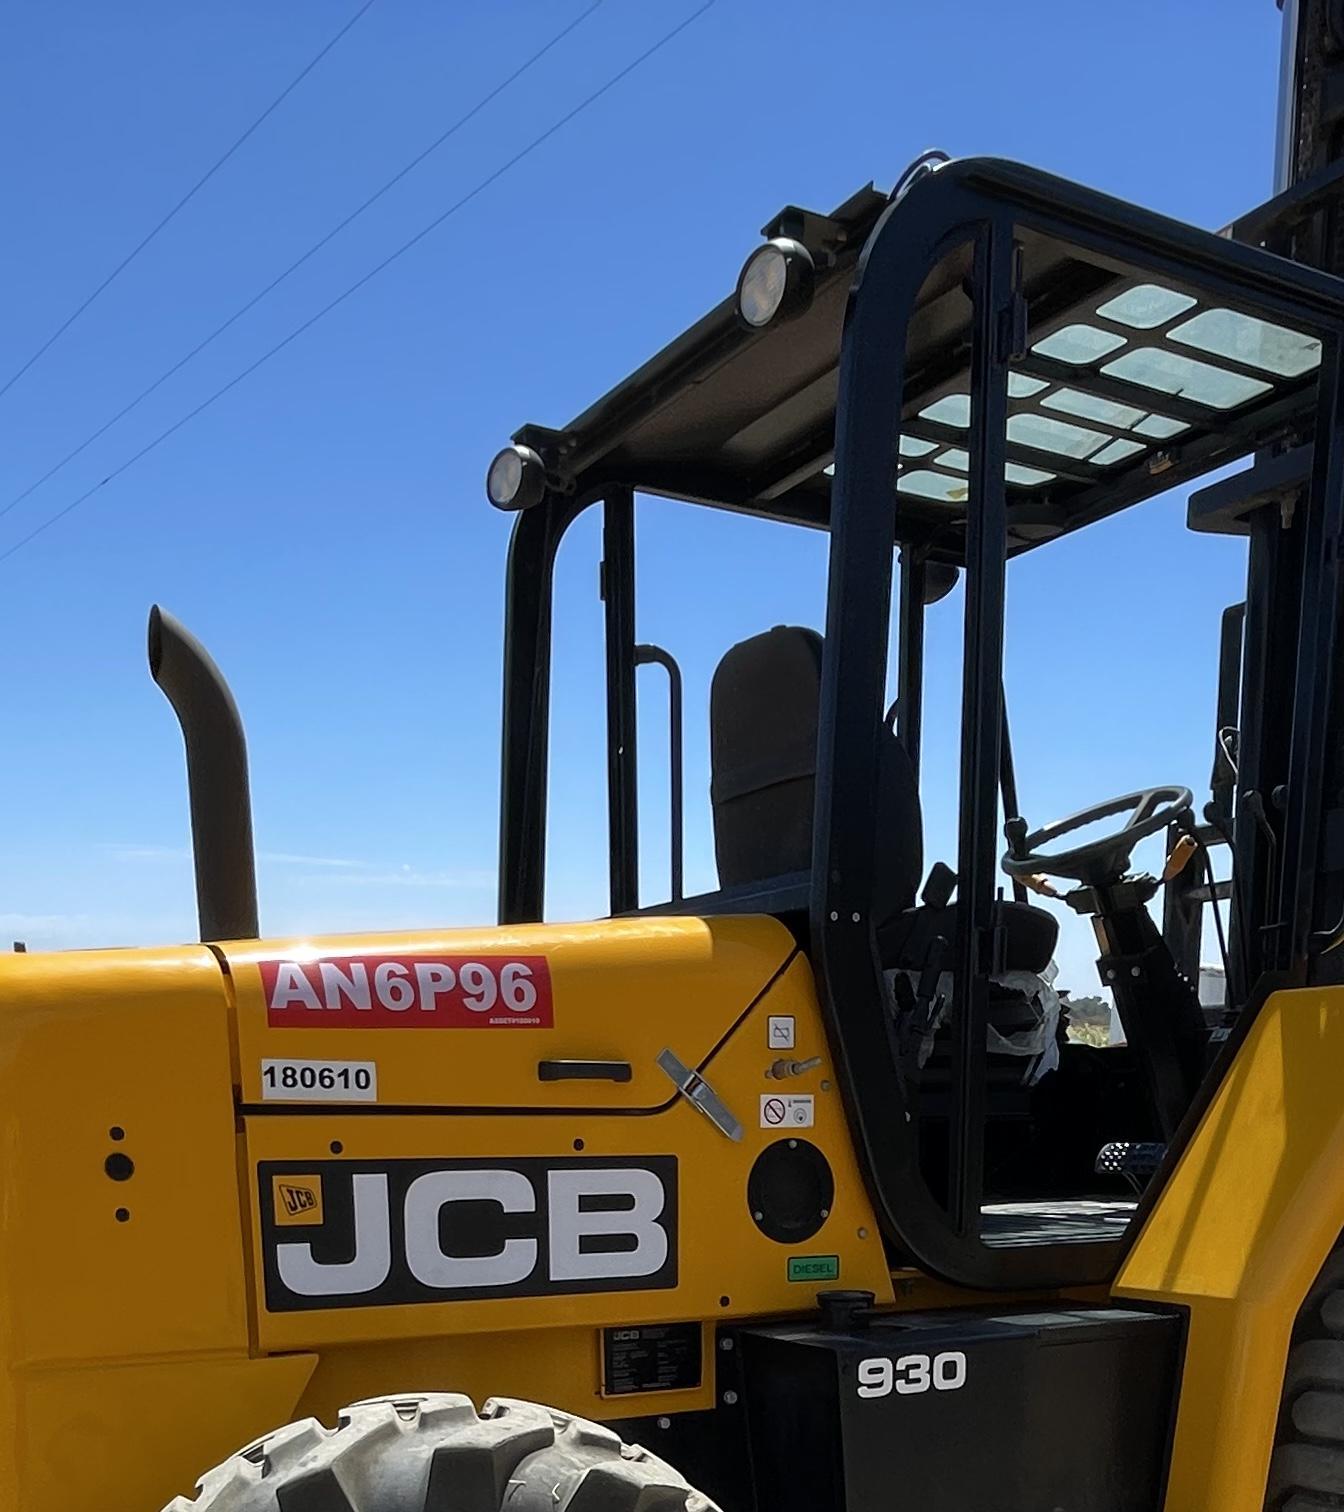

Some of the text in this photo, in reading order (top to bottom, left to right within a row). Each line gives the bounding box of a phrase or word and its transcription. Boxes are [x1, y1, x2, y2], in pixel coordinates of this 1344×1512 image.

[270, 962, 537, 1012] AN6P96
[263, 1066, 371, 1090] 180610
[286, 1188, 314, 1211] JCB
[276, 1169, 668, 1296] JCB
[793, 1263, 834, 1274] DIESEL
[613, 1330, 639, 1341] JCB
[857, 1351, 966, 1398] 930
